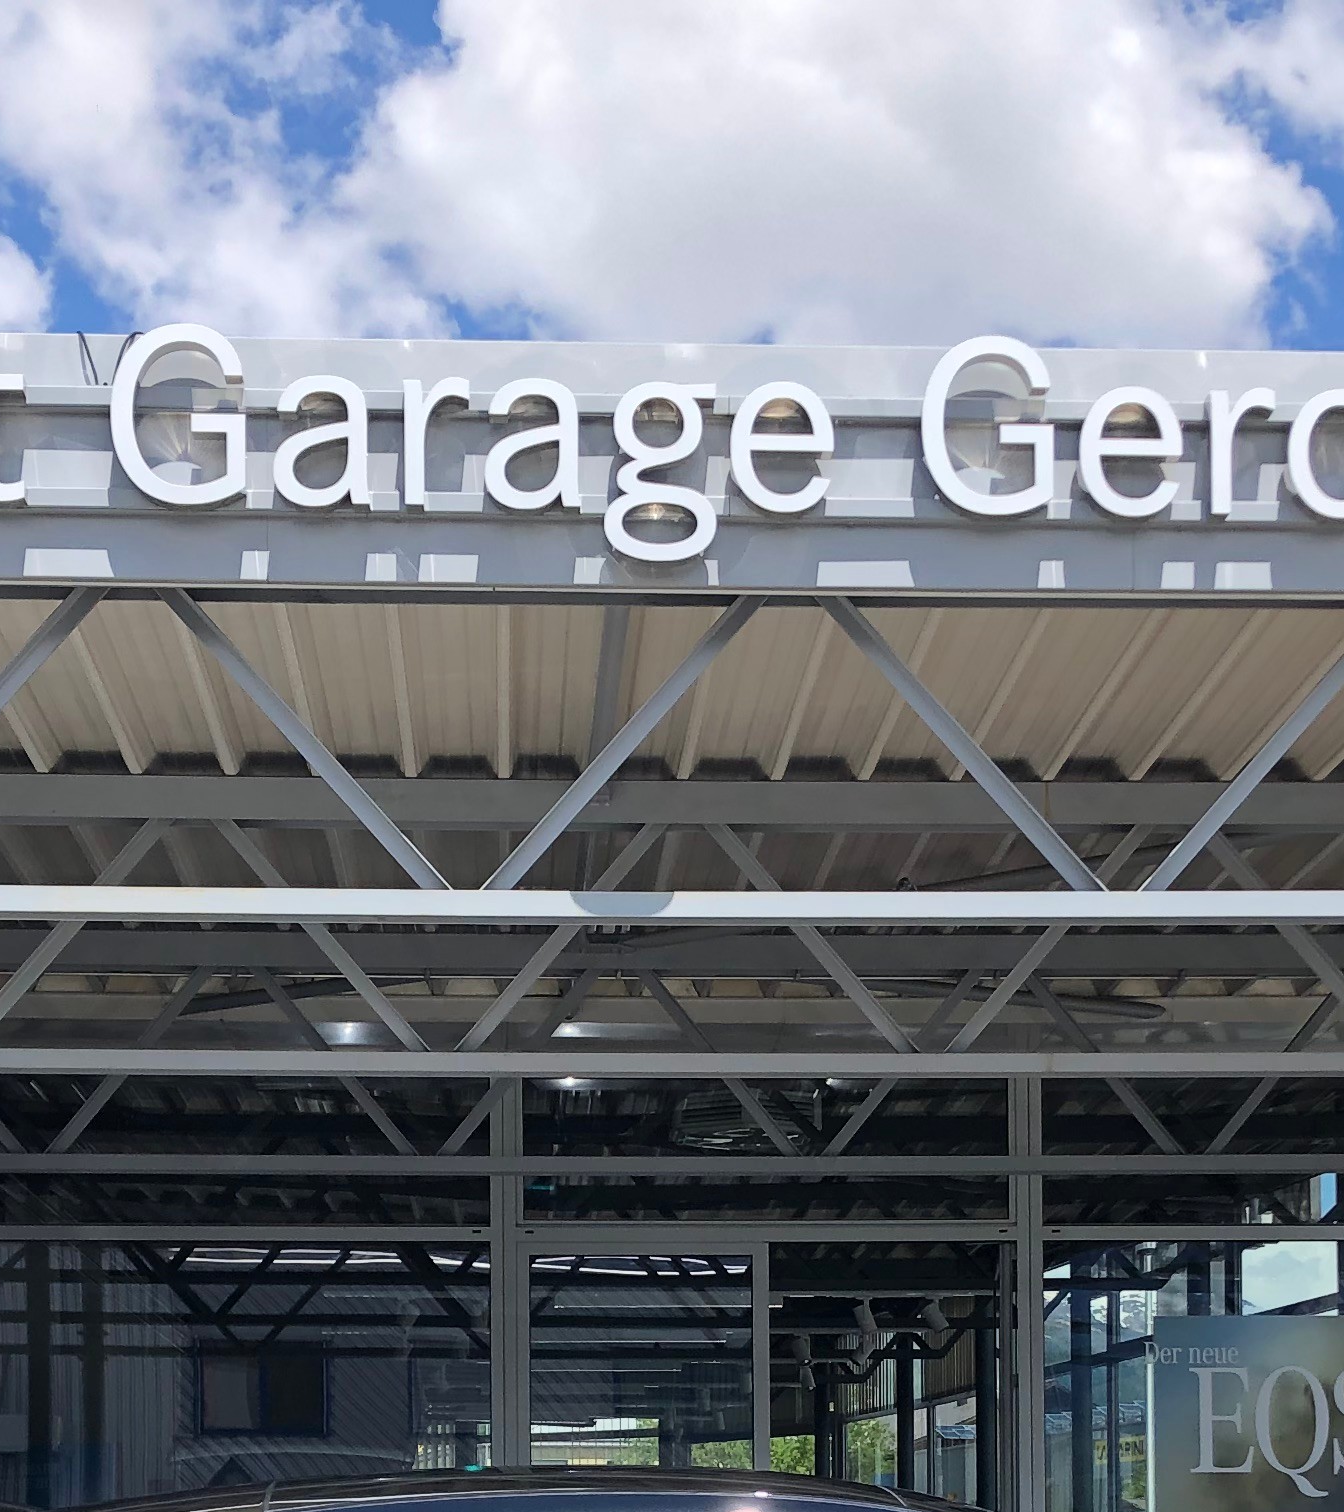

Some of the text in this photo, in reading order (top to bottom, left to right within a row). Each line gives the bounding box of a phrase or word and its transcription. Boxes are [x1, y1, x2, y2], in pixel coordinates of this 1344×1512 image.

[109, 322, 835, 562] Garage
[1143, 1341, 1239, 1365] Der neue
